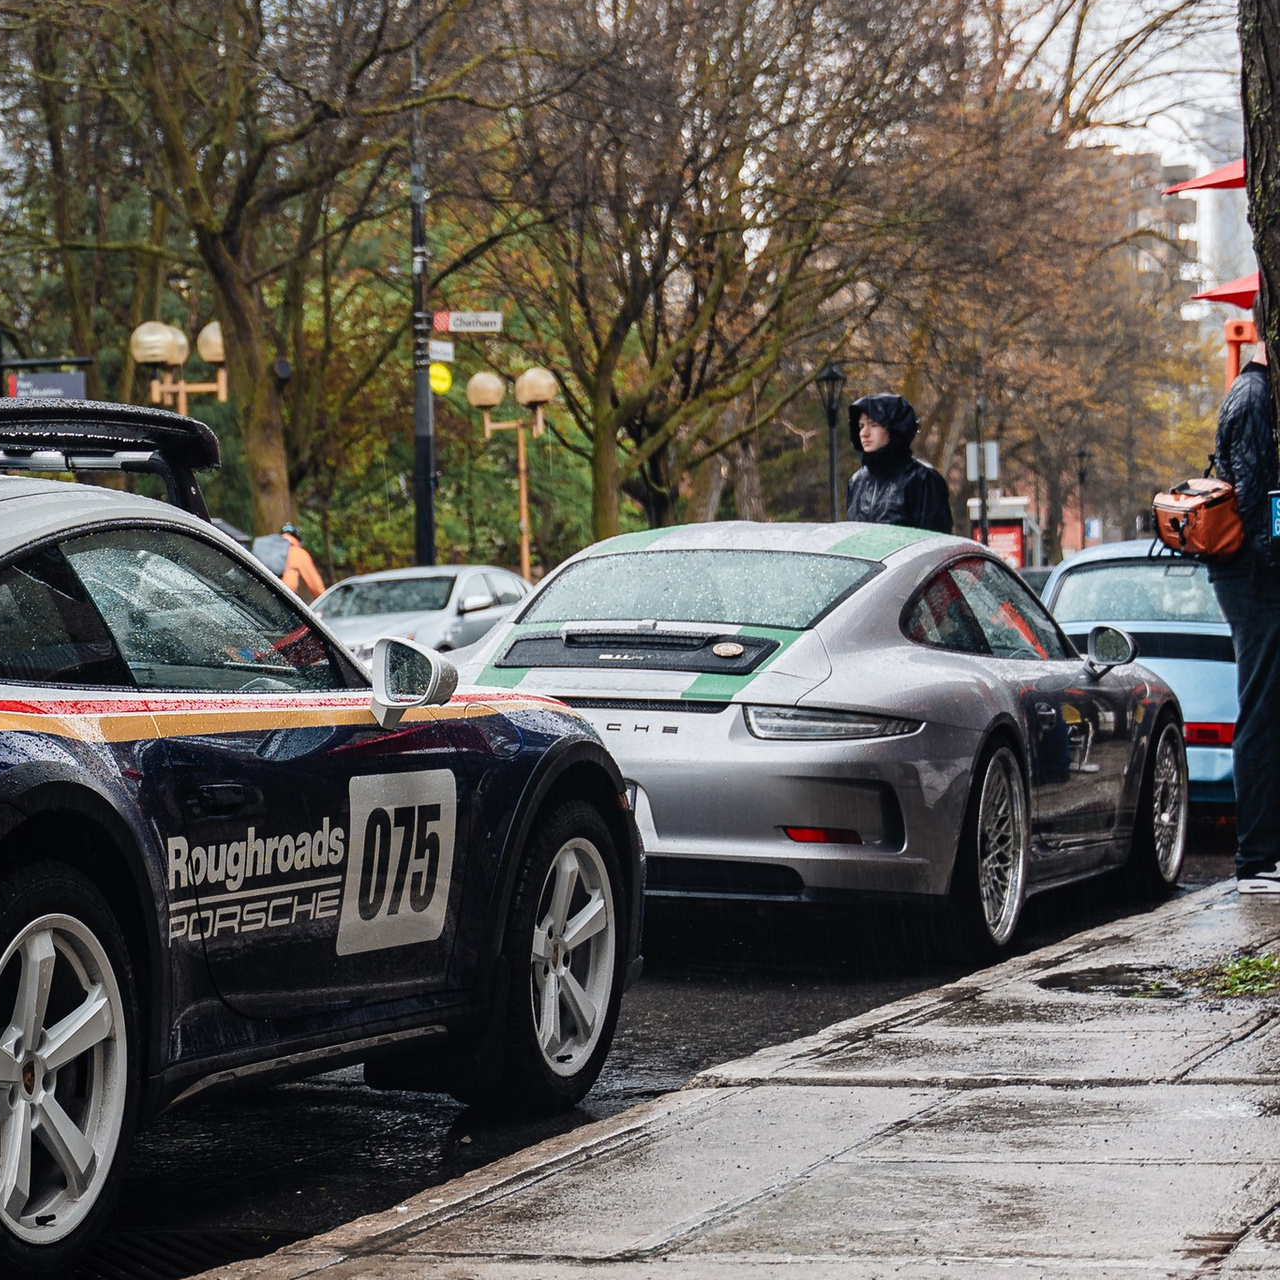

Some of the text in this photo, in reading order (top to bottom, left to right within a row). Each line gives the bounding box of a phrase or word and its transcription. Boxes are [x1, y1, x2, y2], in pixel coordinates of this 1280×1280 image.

[452, 316, 497, 329] Chatham
[167, 816, 345, 891] Roughroads
[357, 803, 442, 921] 075
[168, 888, 341, 948] PORSCHE
